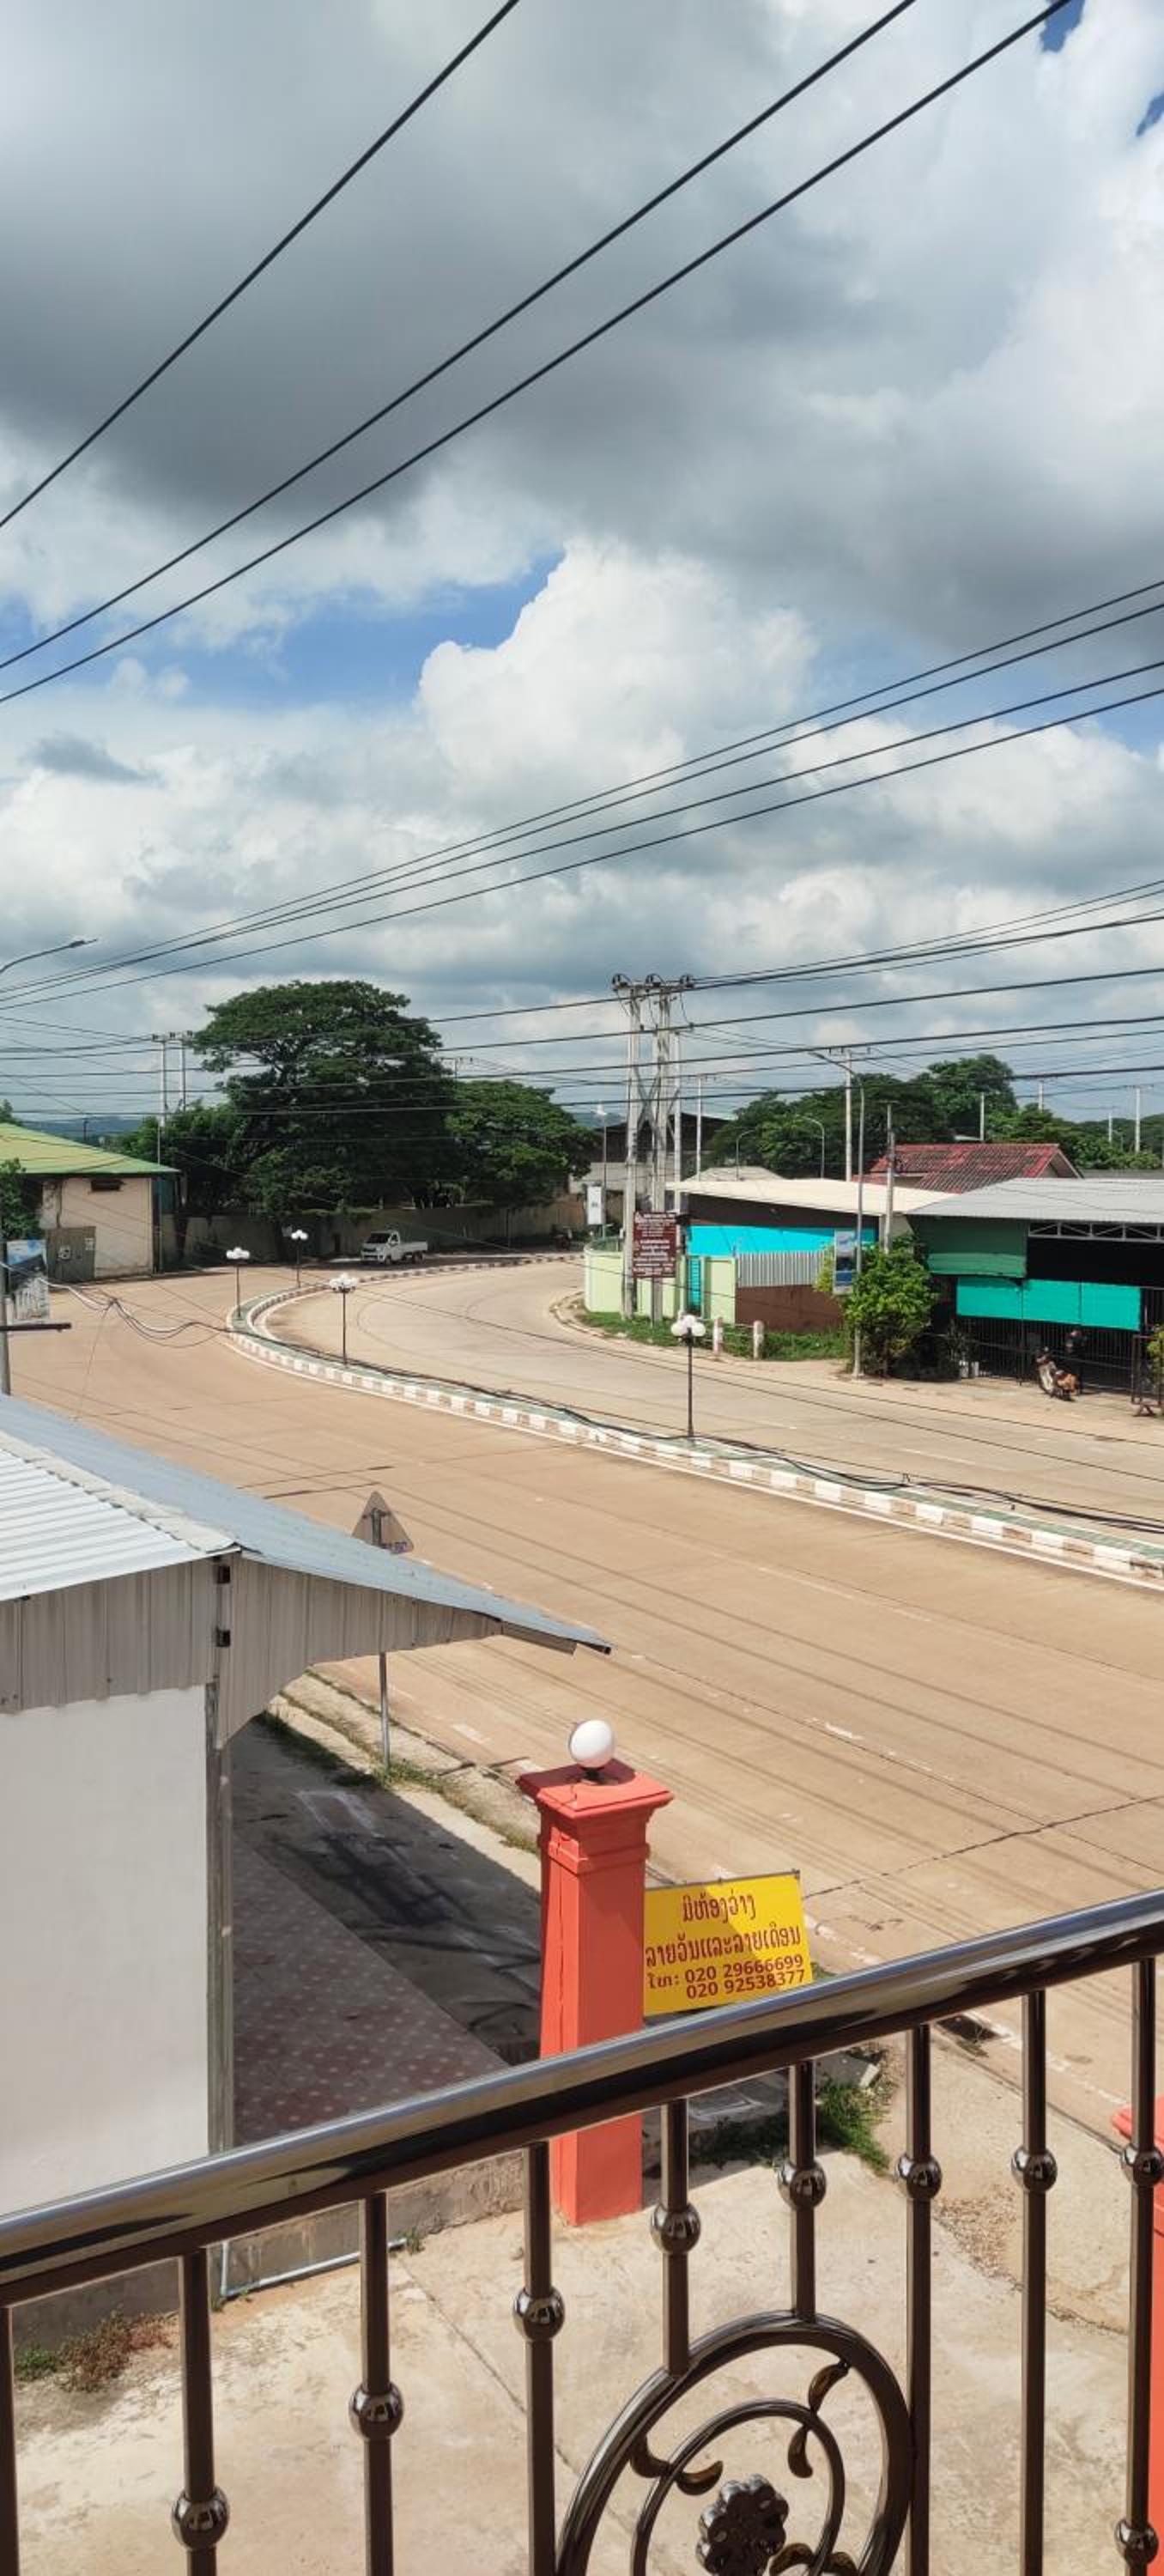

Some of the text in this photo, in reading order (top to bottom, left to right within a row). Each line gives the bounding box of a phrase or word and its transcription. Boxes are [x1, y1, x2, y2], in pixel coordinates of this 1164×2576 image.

[684, 1965, 717, 1984] 020
[723, 1953, 803, 1978] 29666699
[686, 1969, 804, 1999] 020 92538377
